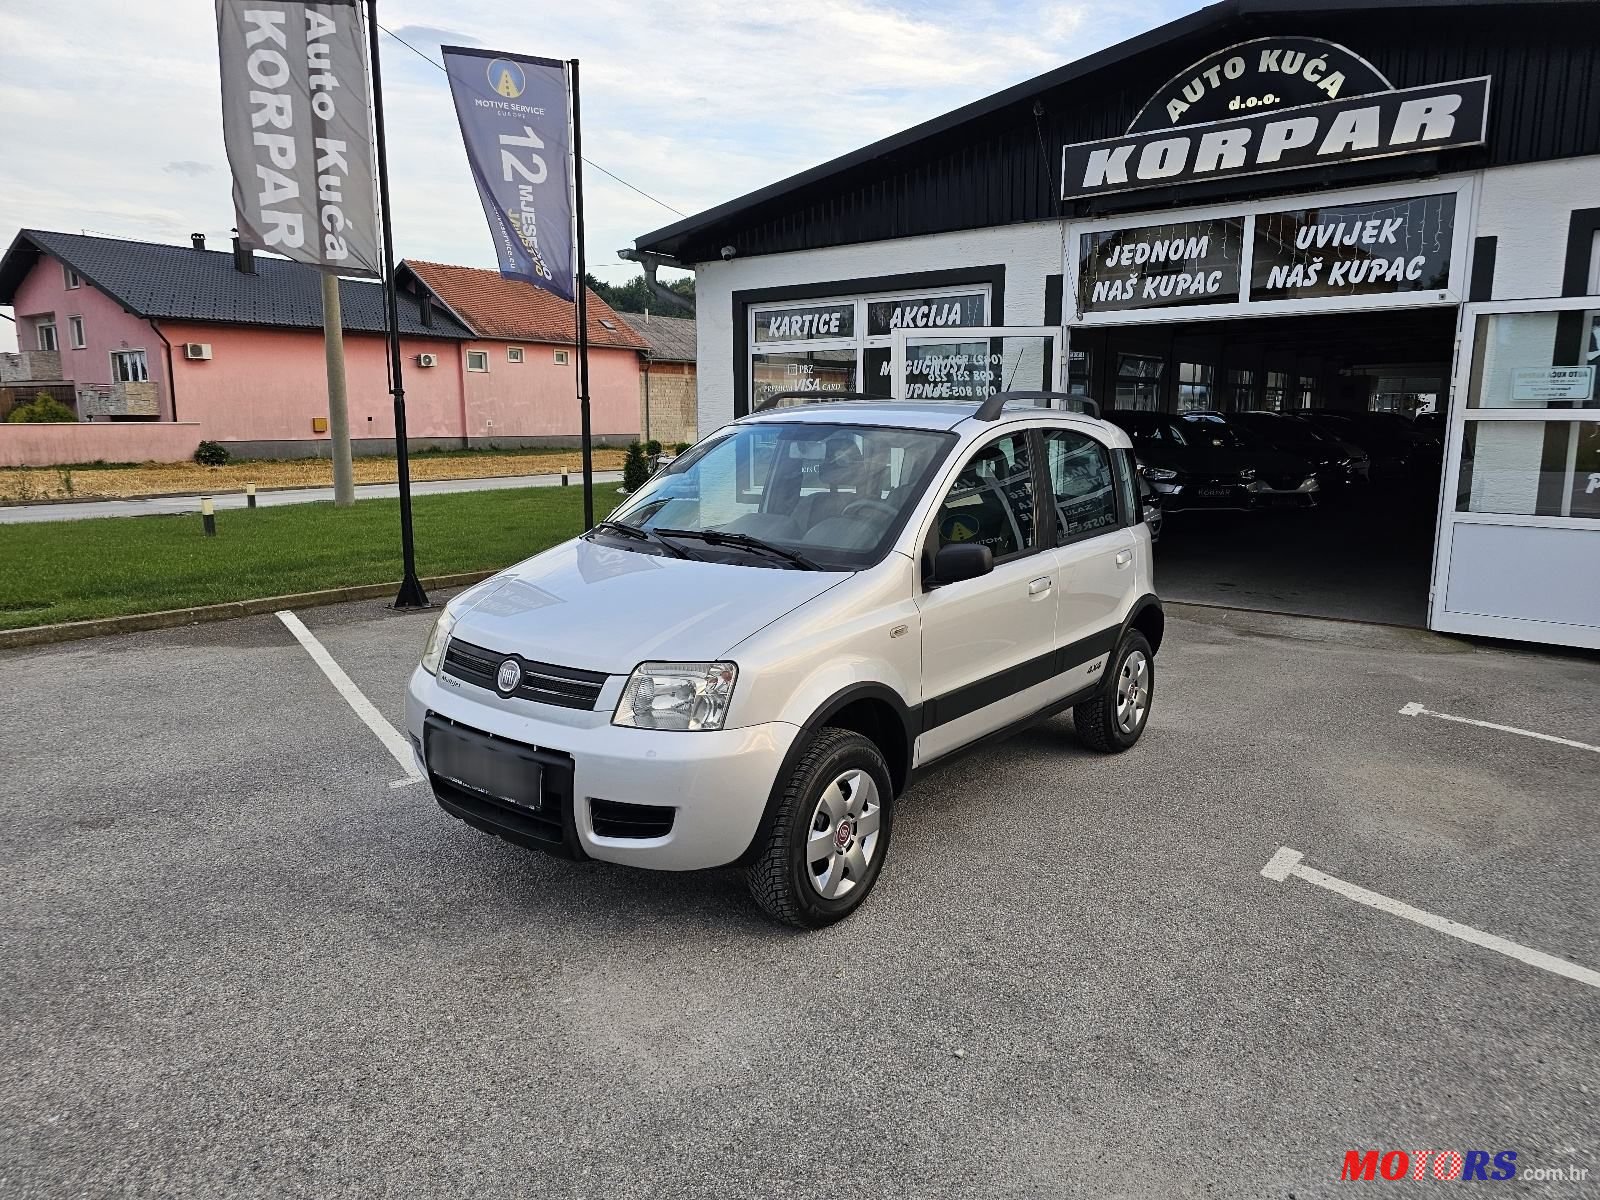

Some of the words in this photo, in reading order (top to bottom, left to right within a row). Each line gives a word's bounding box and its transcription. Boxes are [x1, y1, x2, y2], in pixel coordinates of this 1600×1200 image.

[305, 8, 340, 121] Auto
[1165, 56, 1246, 124] AUTO
[1258, 49, 1346, 99] KUĆA
[1228, 93, 1281, 111] d.o.o.
[475, 99, 509, 110] MOTIVE
[511, 103, 545, 116] SERVICE
[243, 9, 305, 249] KORPAR
[1081, 93, 1462, 189] KORPAR
[499, 125, 548, 185] 12
[315, 137, 353, 260] Kuća
[1296, 217, 1404, 250] UVIJEK
[1106, 235, 1210, 268] JEDNOM
[1091, 272, 1139, 303] NAŠ
[1143, 270, 1223, 299] KUPAC
[1265, 255, 1323, 290] NAŠ
[1326, 254, 1427, 286] KUPAC
[768, 312, 841, 338] KARTICE
[889, 302, 962, 328] AKCIJA
[795, 378, 820, 391] VISA
[822, 383, 840, 391] CARD
[800, 364, 814, 374] PBZ
